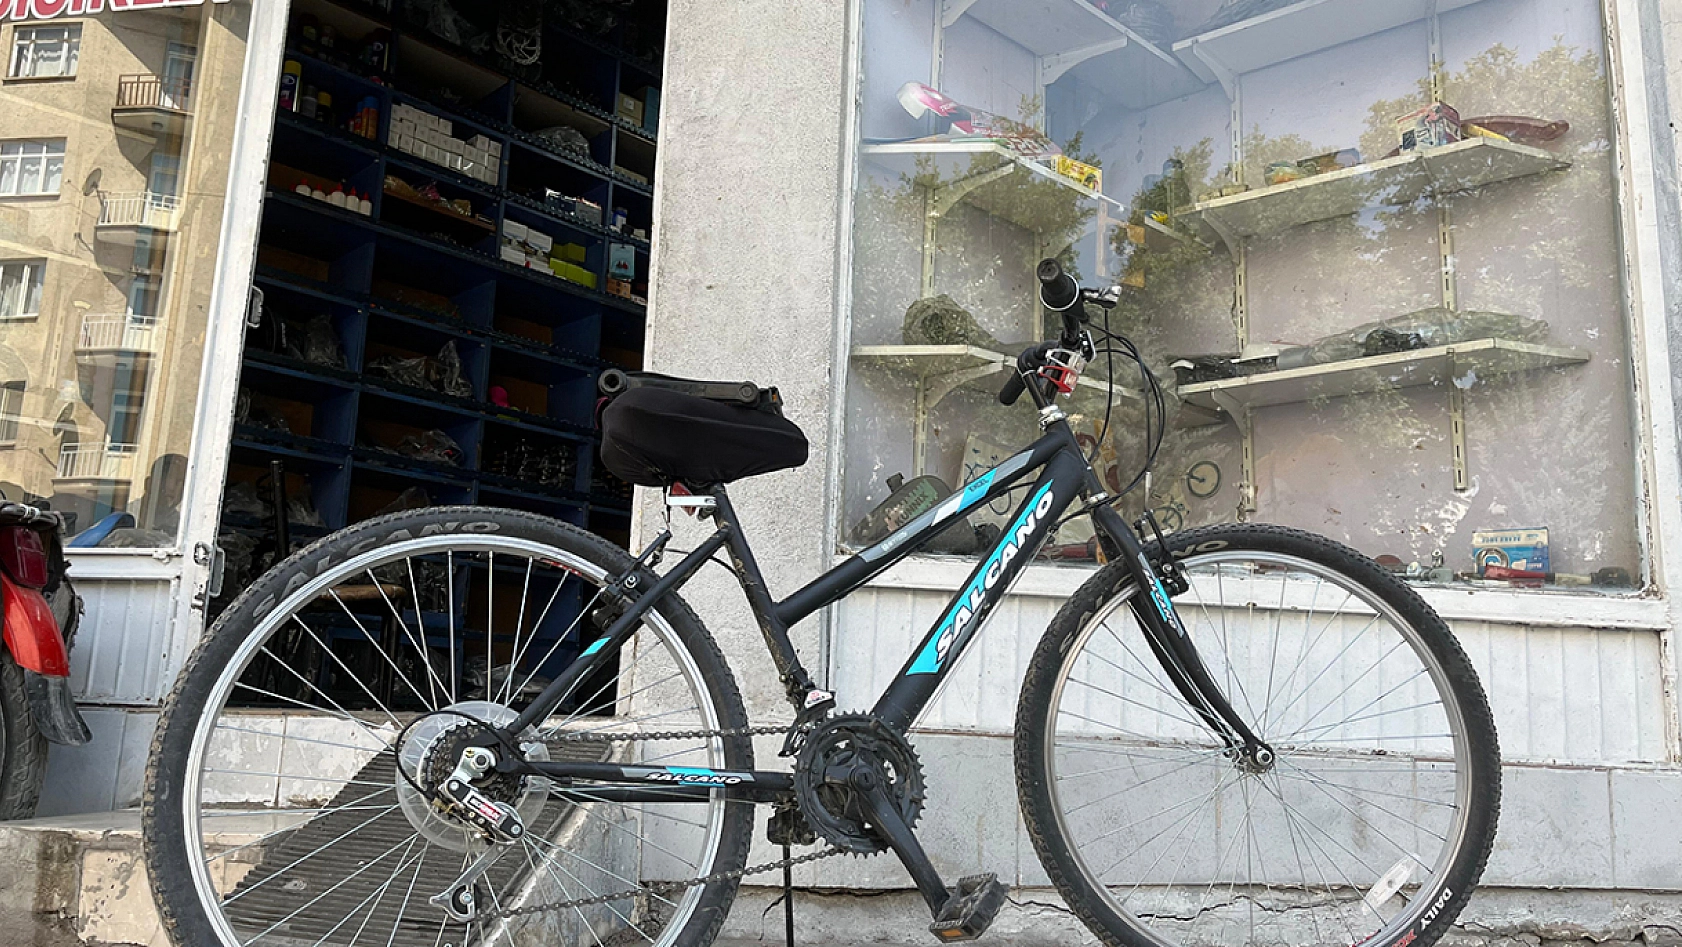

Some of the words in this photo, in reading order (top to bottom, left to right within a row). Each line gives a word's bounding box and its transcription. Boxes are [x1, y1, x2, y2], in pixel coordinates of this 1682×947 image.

[253, 521, 500, 622] SALCANO
[935, 490, 1054, 664] SALCANO
[645, 772, 742, 785] SALCANO
[1420, 887, 1453, 931] DAILY
